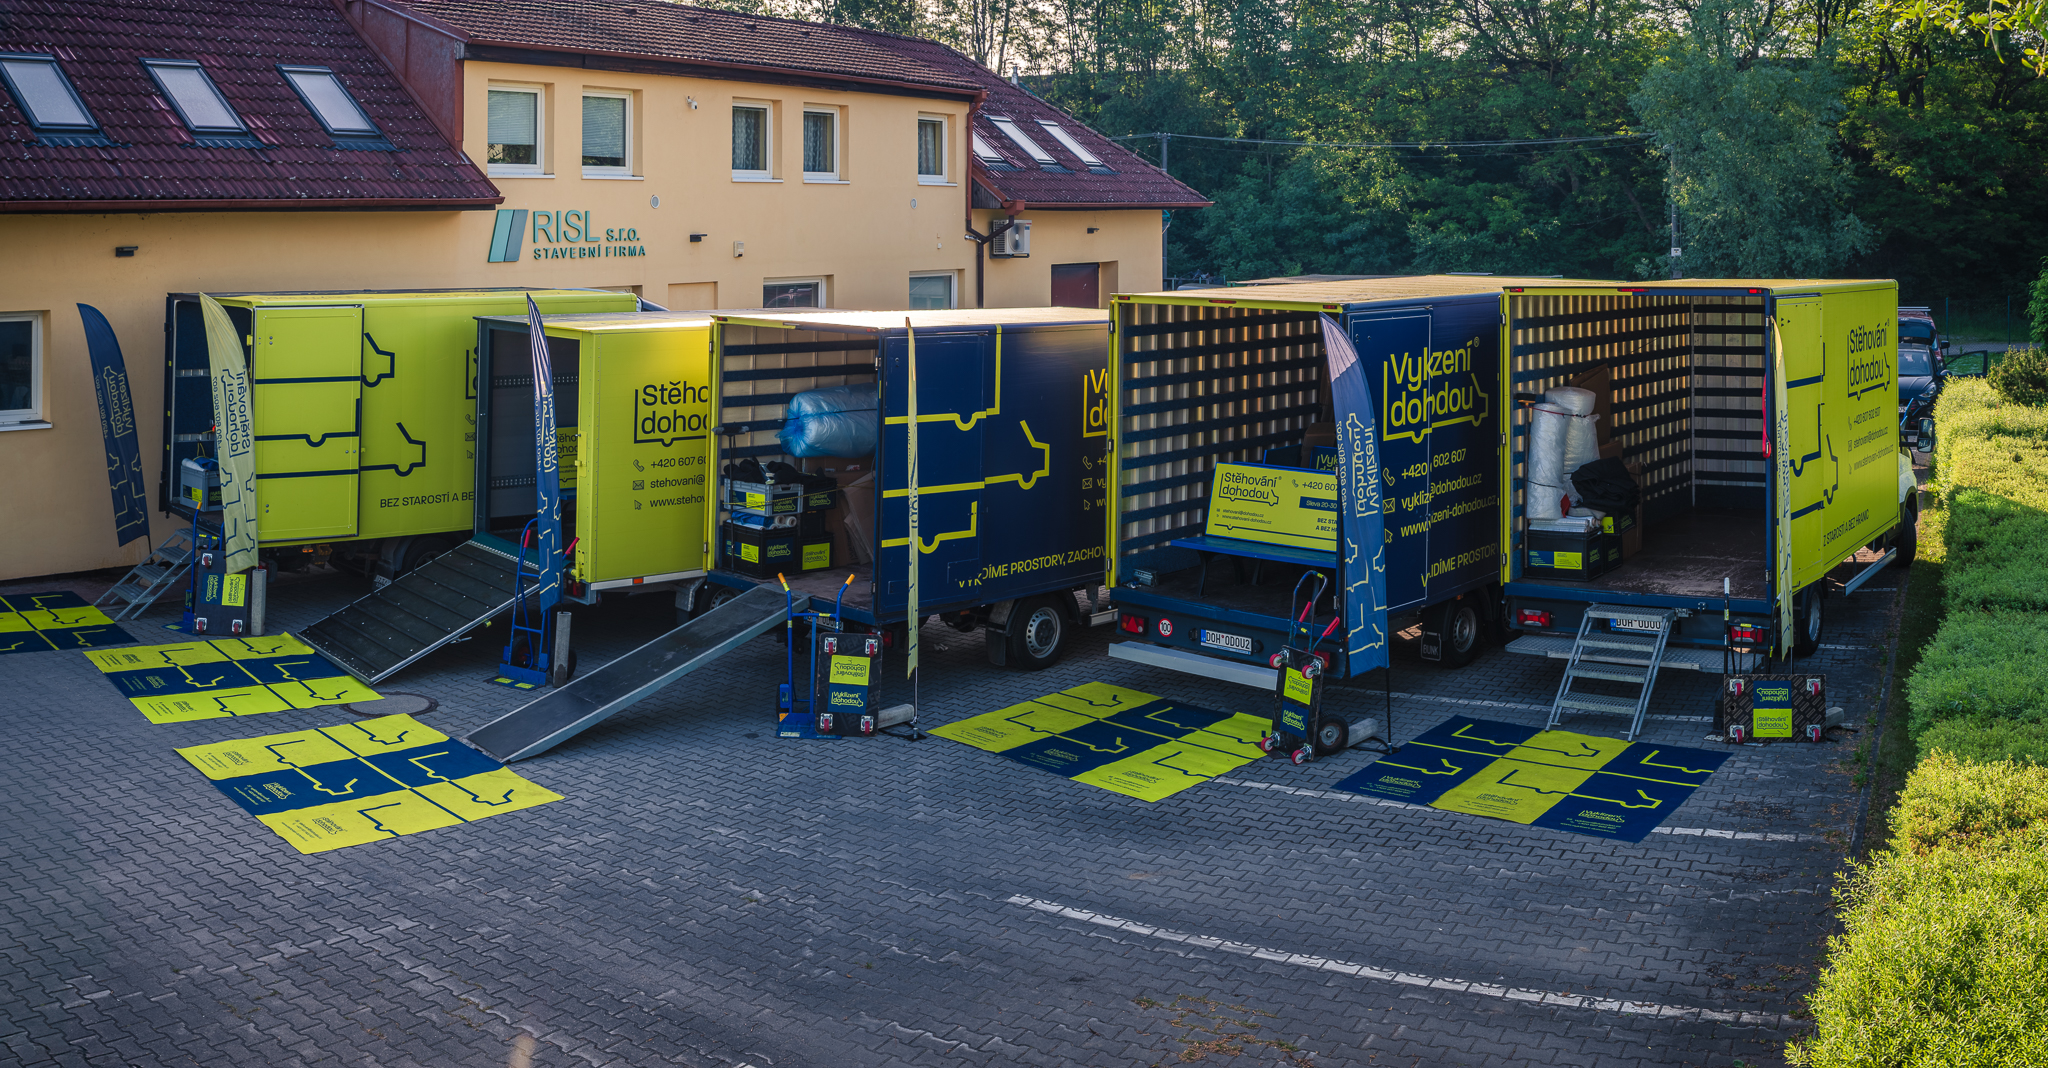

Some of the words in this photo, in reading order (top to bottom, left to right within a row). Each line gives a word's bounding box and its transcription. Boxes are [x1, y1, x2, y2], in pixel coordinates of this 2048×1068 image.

[533, 210, 600, 243] RISL
[606, 228, 641, 242] s.r.o.
[534, 244, 601, 260] STAVEBNÍ
[605, 245, 646, 257] FIRMA
[1850, 322, 1887, 354] Stěhování
[1850, 355, 1884, 387] dohodou
[651, 458, 676, 468] +420
[678, 456, 696, 467] 607
[1401, 462, 1428, 479] +420
[1433, 452, 1450, 468] 602
[1451, 448, 1467, 463] 607
[1224, 472, 1277, 488] Stěhování
[1302, 481, 1323, 490] +420
[380, 498, 400, 508] BEZ
[402, 492, 450, 507] STAROSTÍ
[452, 493, 459, 502] A
[1222, 484, 1270, 500] dohodou
[1011, 552, 1066, 575] PROSTORY,
[1160, 621, 1172, 633] 100
